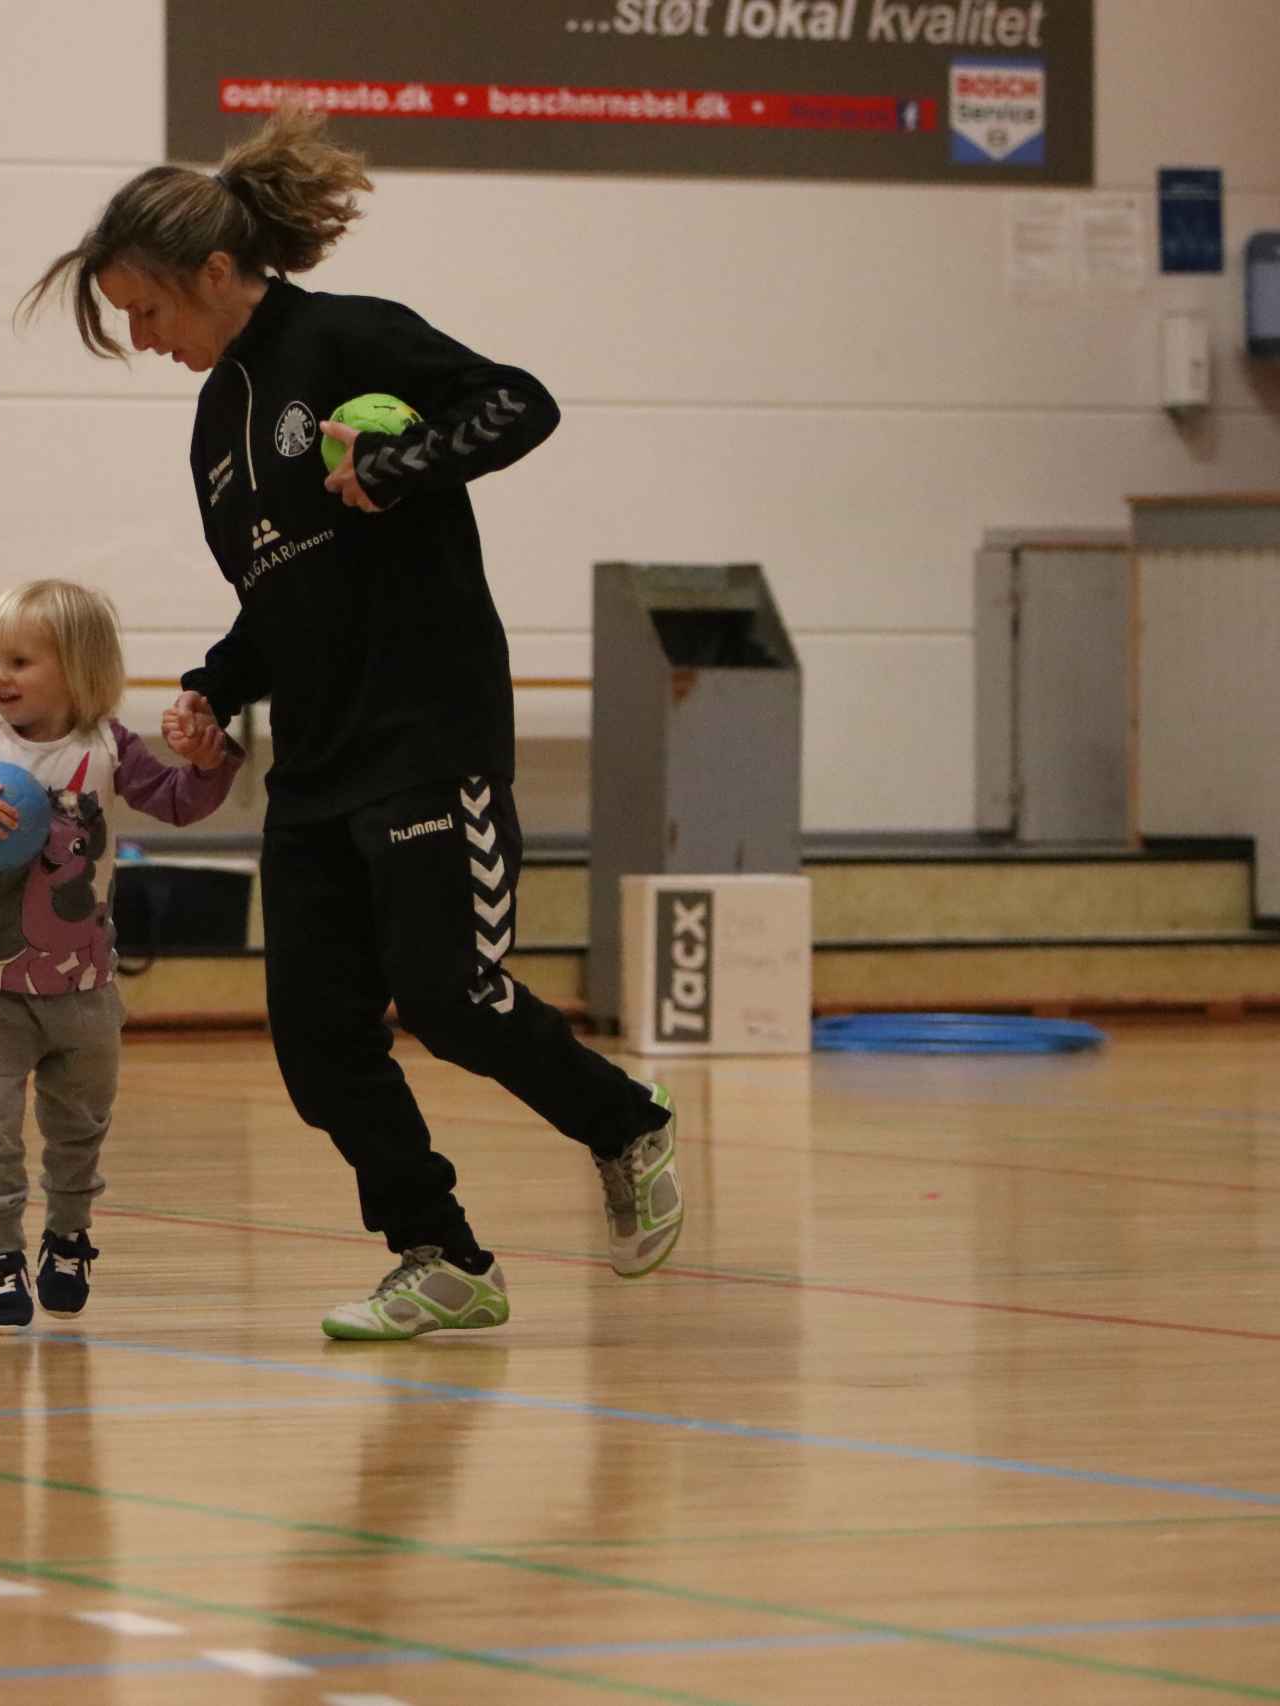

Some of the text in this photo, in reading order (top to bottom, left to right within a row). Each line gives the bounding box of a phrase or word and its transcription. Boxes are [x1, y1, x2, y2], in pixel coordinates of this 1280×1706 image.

[724, 0, 853, 41] lokal
[867, 0, 1043, 47] kvalitet
[956, 75, 1039, 97] BOSCH
[959, 102, 1036, 122] Service
[389, 812, 454, 844] hummel
[661, 898, 707, 1036] Tacx
